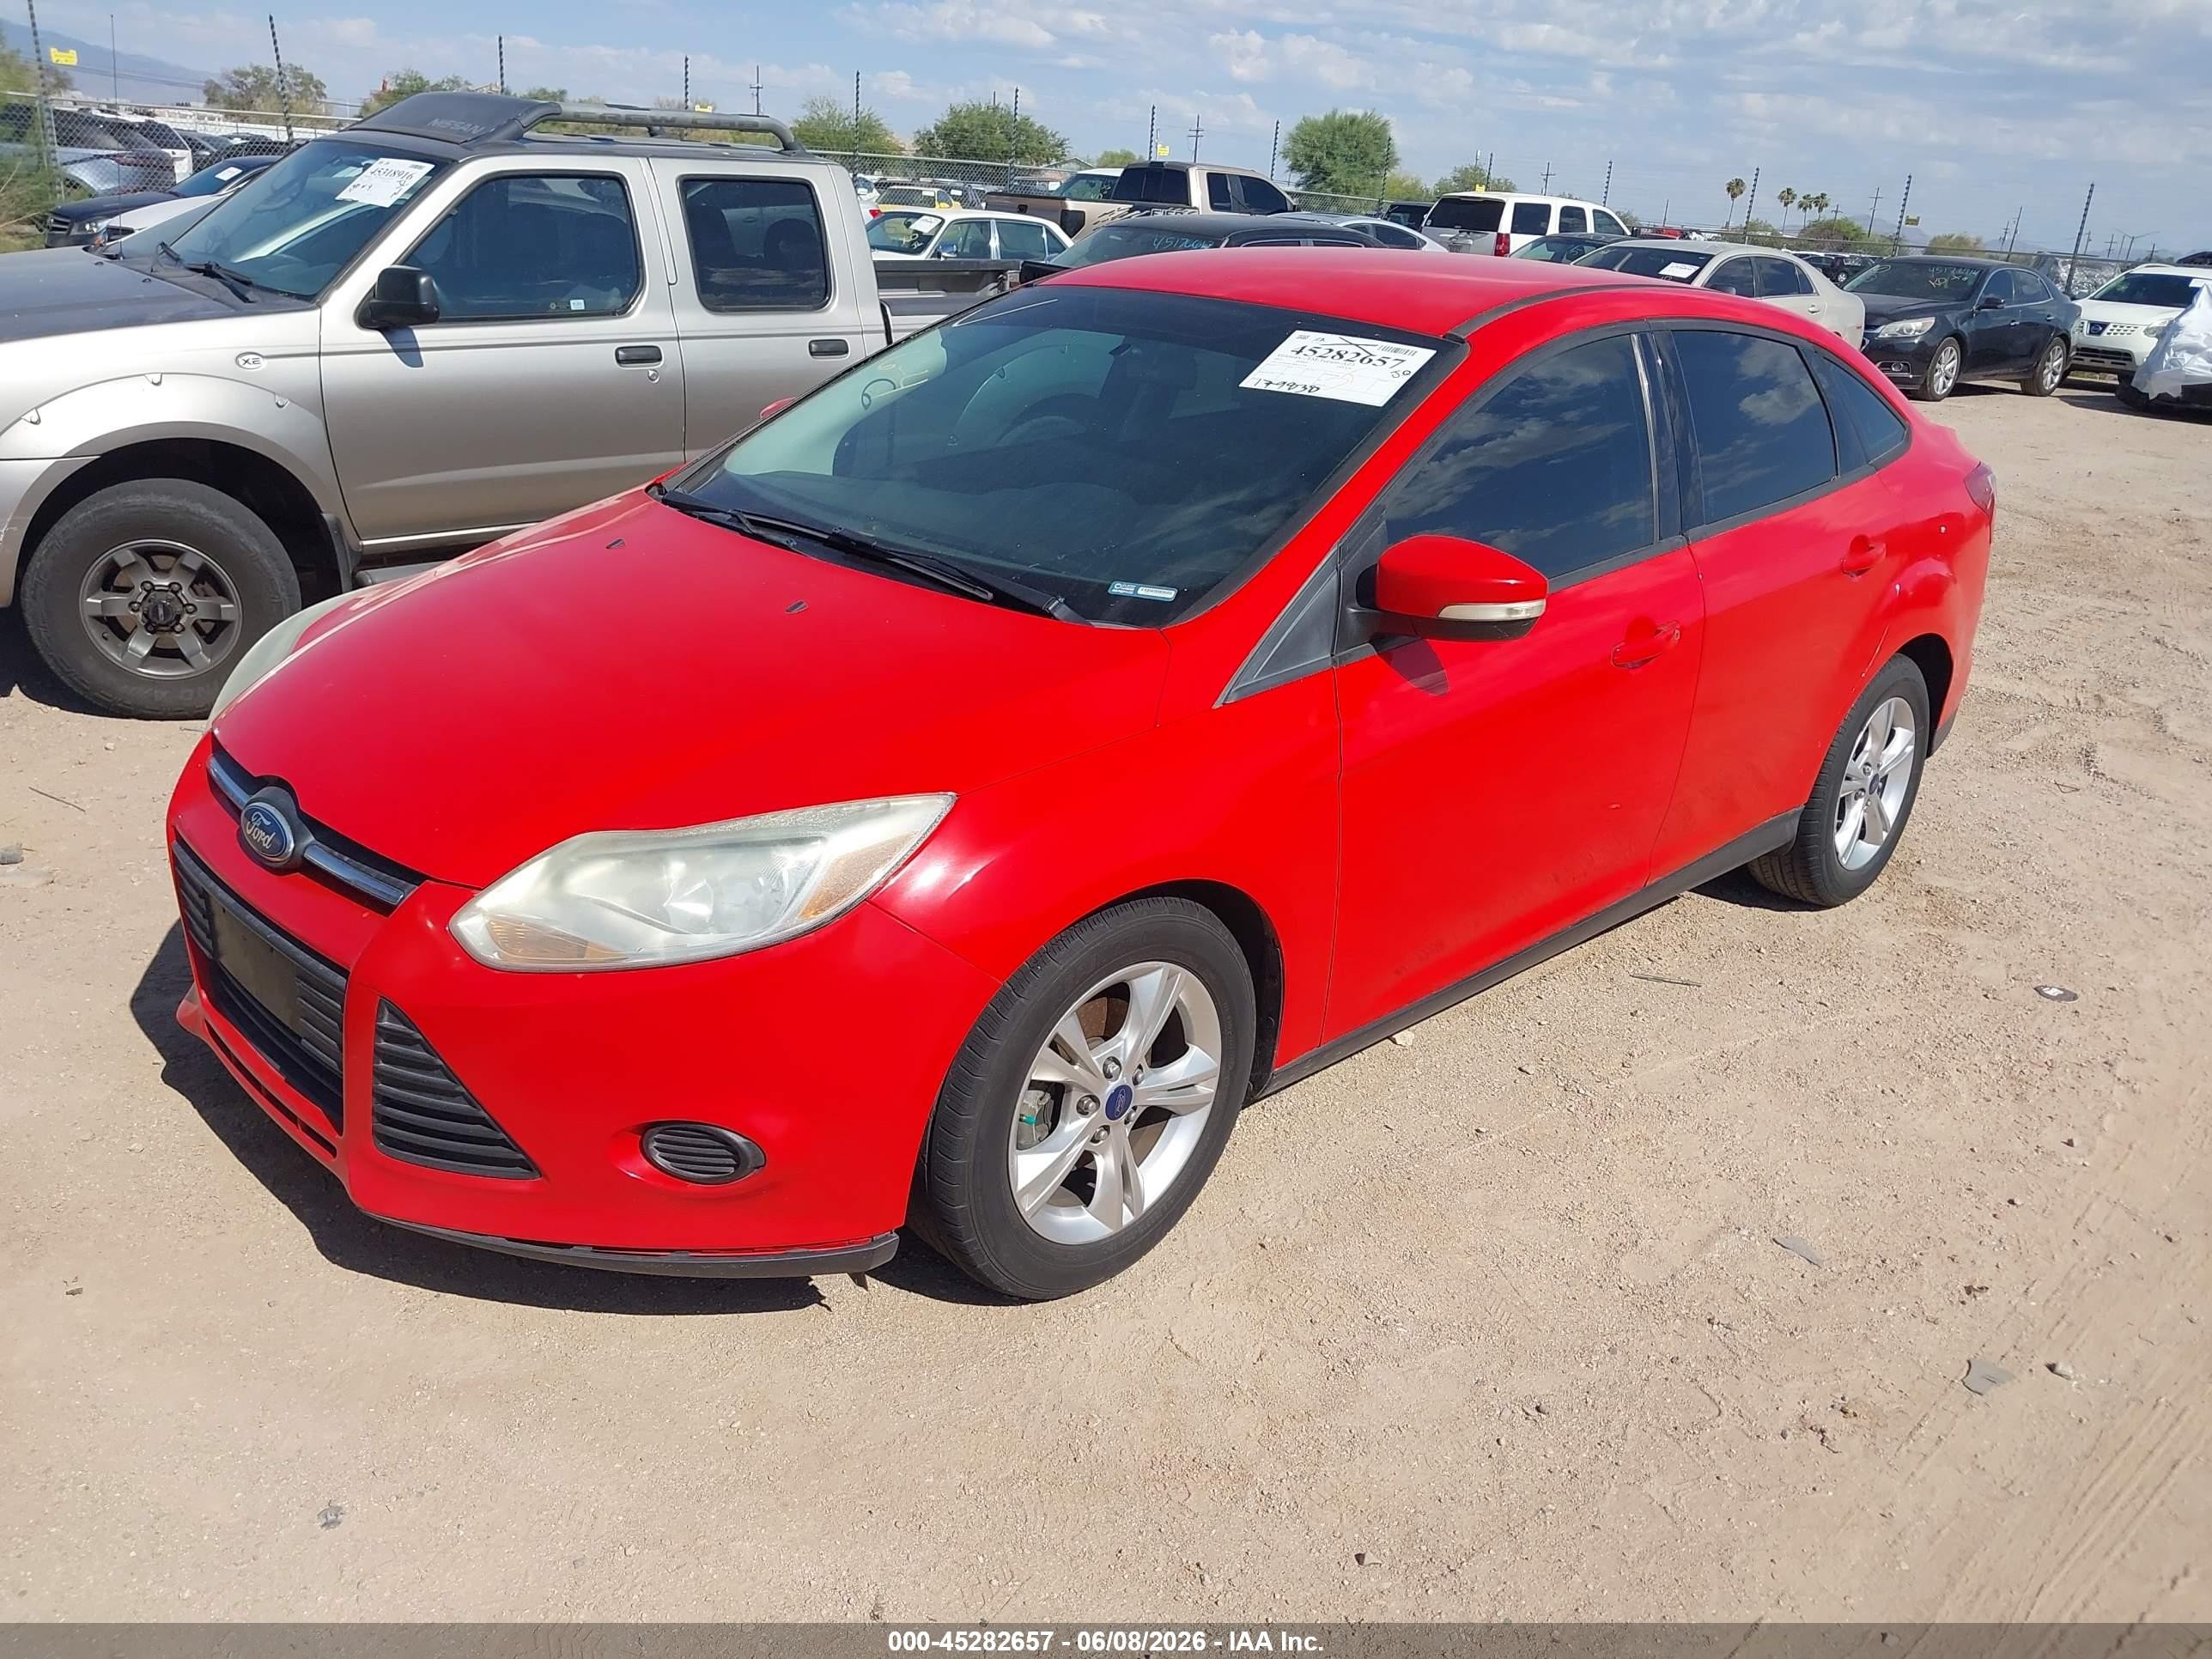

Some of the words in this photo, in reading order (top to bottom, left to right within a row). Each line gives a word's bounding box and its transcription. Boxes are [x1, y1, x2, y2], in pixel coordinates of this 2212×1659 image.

[241, 357, 262, 366] XE
[1291, 344, 1407, 369] 45282657
[246, 811, 276, 848] Ford
